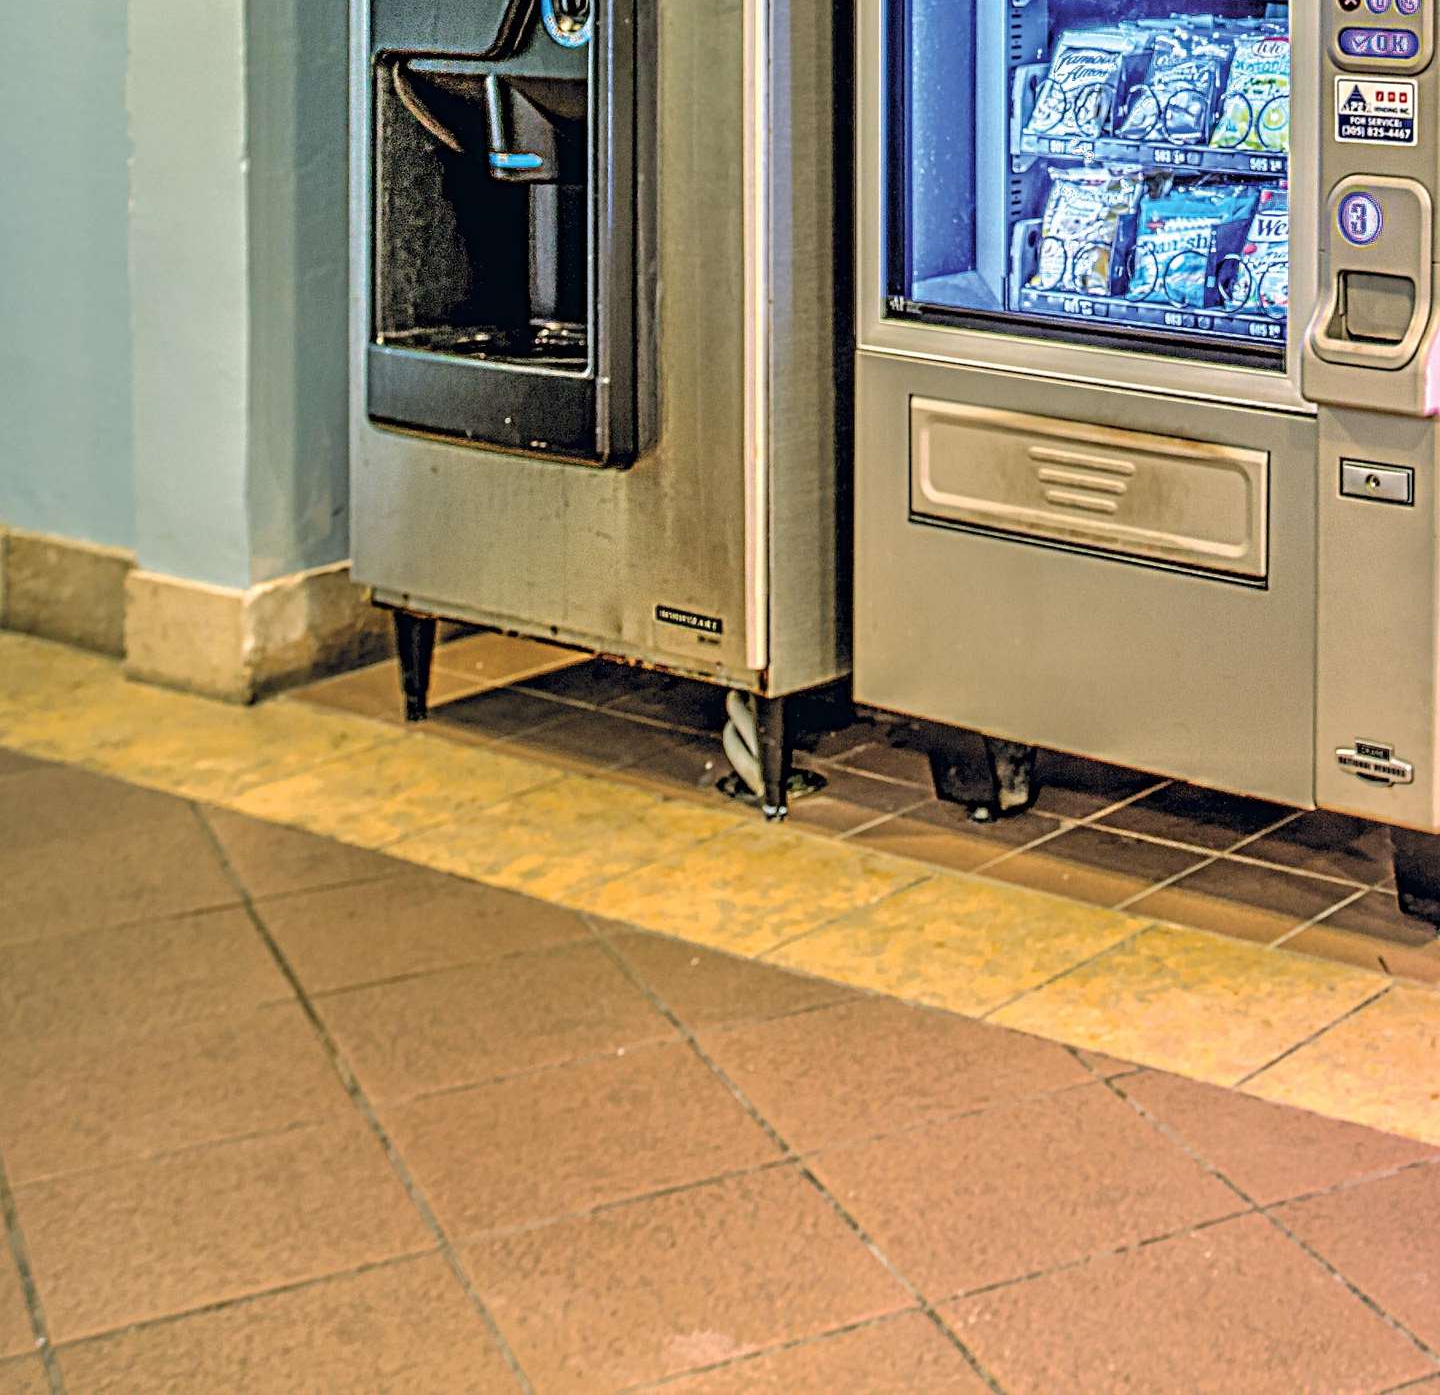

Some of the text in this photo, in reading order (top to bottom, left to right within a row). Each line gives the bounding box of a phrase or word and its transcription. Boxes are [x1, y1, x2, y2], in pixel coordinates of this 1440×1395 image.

[1054, 53, 1118, 73] Famous
[1058, 65, 1109, 86] Amos
[1342, 125, 1366, 138] (305)
[1349, 116, 1403, 128] FOR SERVICE:
[1257, 218, 1289, 237] We
[1351, 203, 1367, 235] 3
